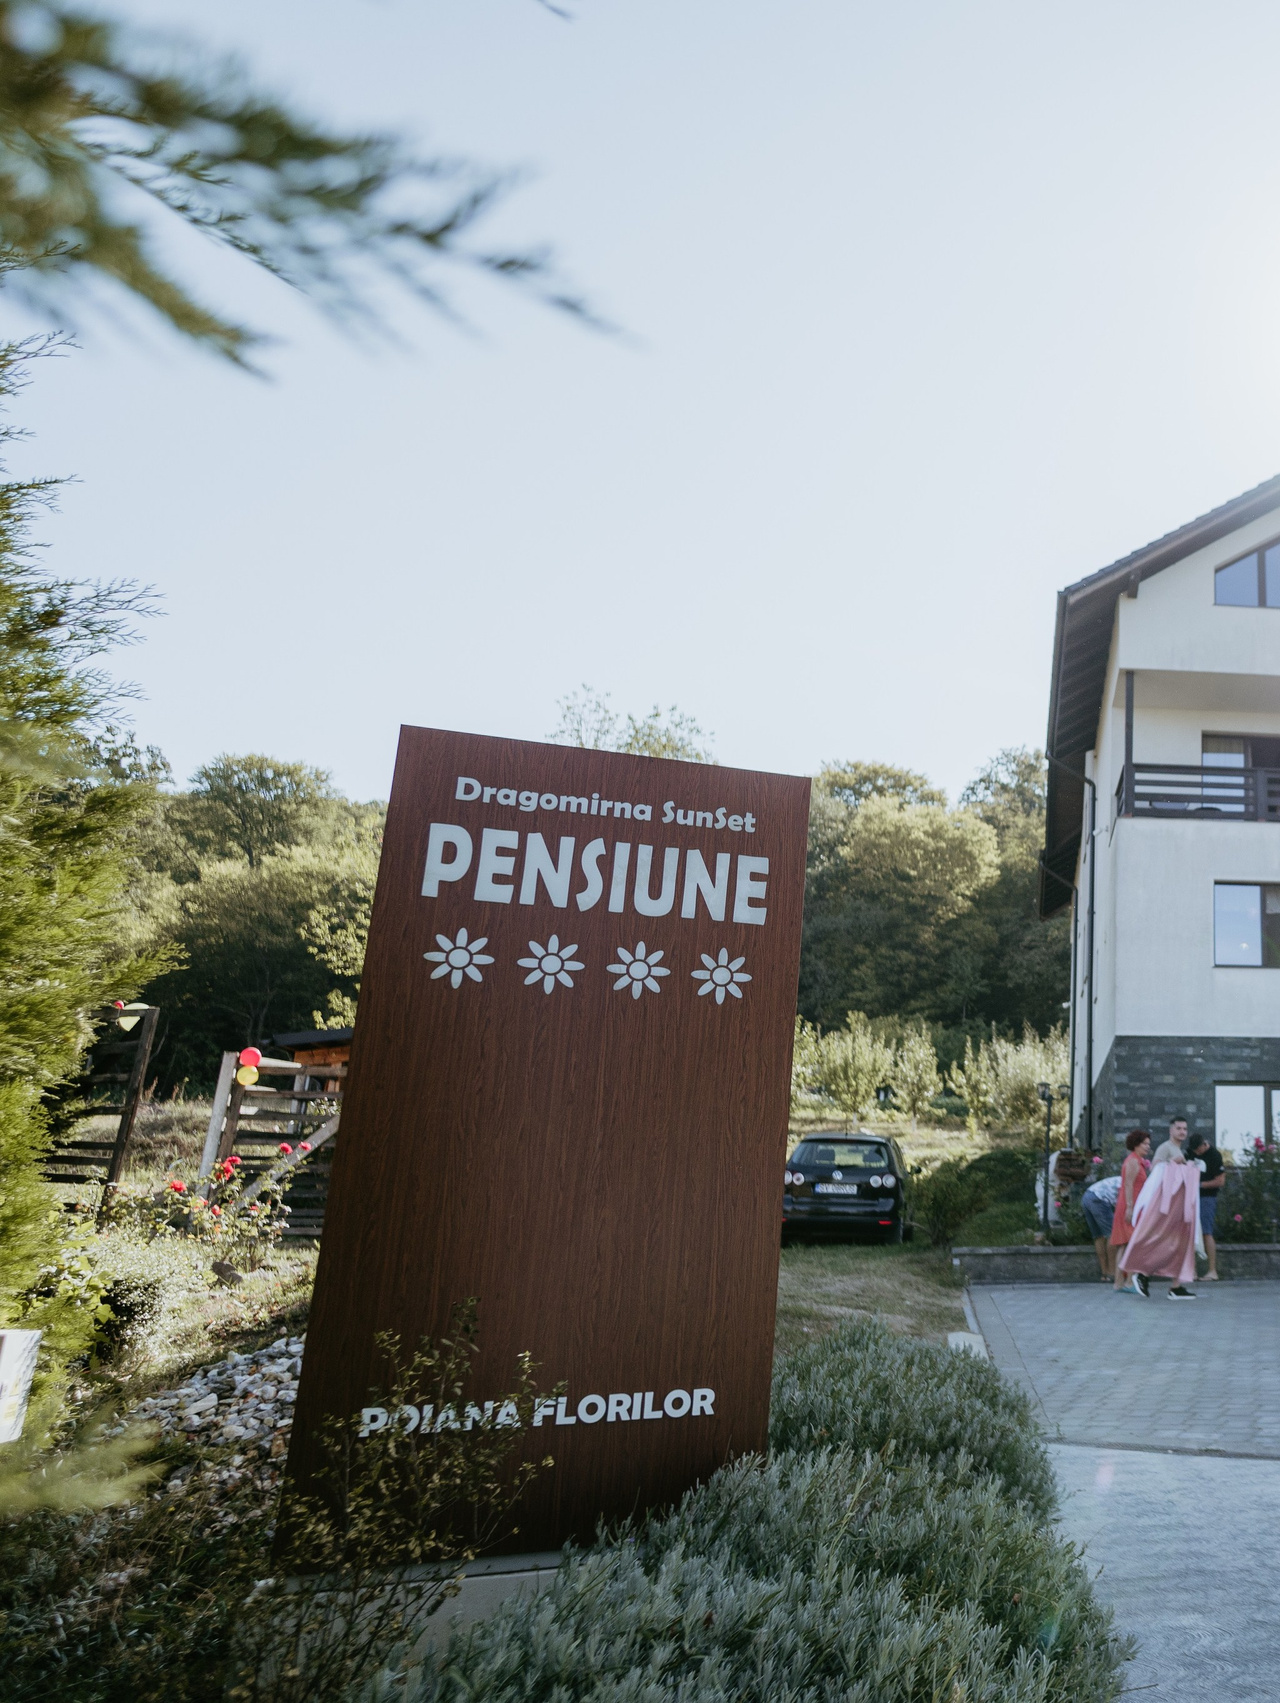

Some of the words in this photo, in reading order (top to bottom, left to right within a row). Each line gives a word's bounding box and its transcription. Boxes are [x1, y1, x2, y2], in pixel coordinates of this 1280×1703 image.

[455, 776, 653, 822] Dragomirna
[661, 800, 757, 833] SunSet
[421, 822, 770, 926] PENSIUNE
[532, 1387, 716, 1427] FLORILOR
